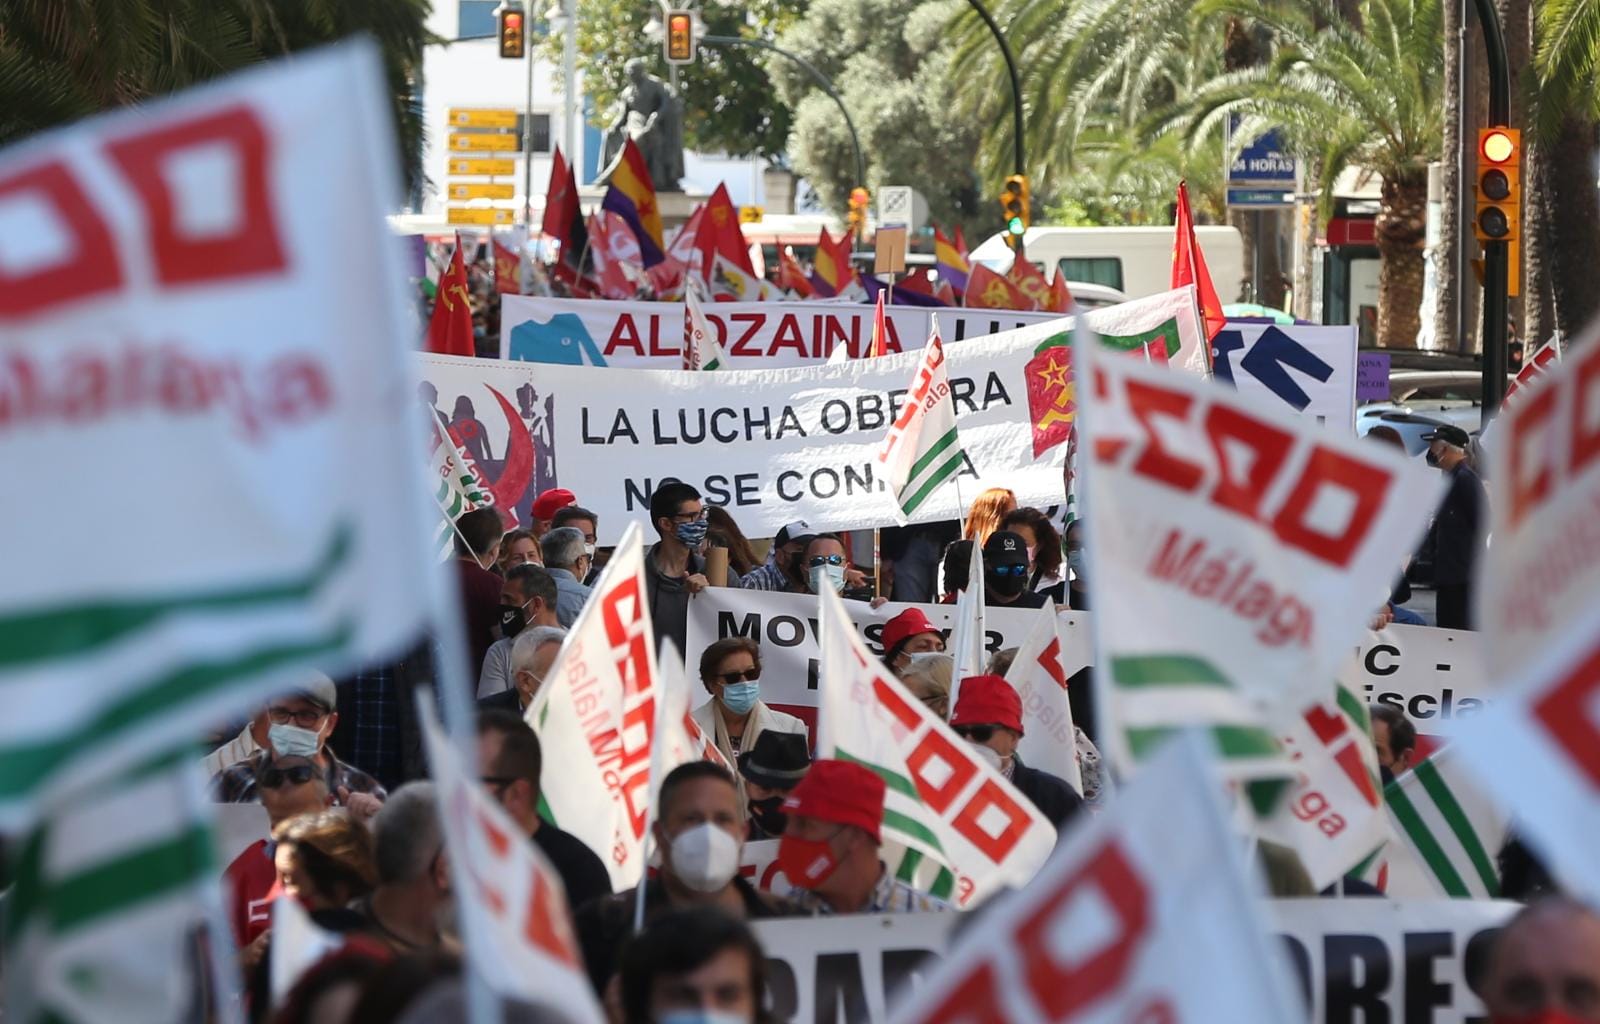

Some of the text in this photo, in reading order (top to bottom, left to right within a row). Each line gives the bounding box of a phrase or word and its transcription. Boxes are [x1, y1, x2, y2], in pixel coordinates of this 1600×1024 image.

[1251, 158, 1294, 172] HORAS
[581, 407, 640, 445] LA
[653, 405, 806, 445] LUCHA
[821, 371, 1012, 434] OBRA
[625, 449, 980, 512] N SE CONA
[1362, 684, 1488, 720] scla
